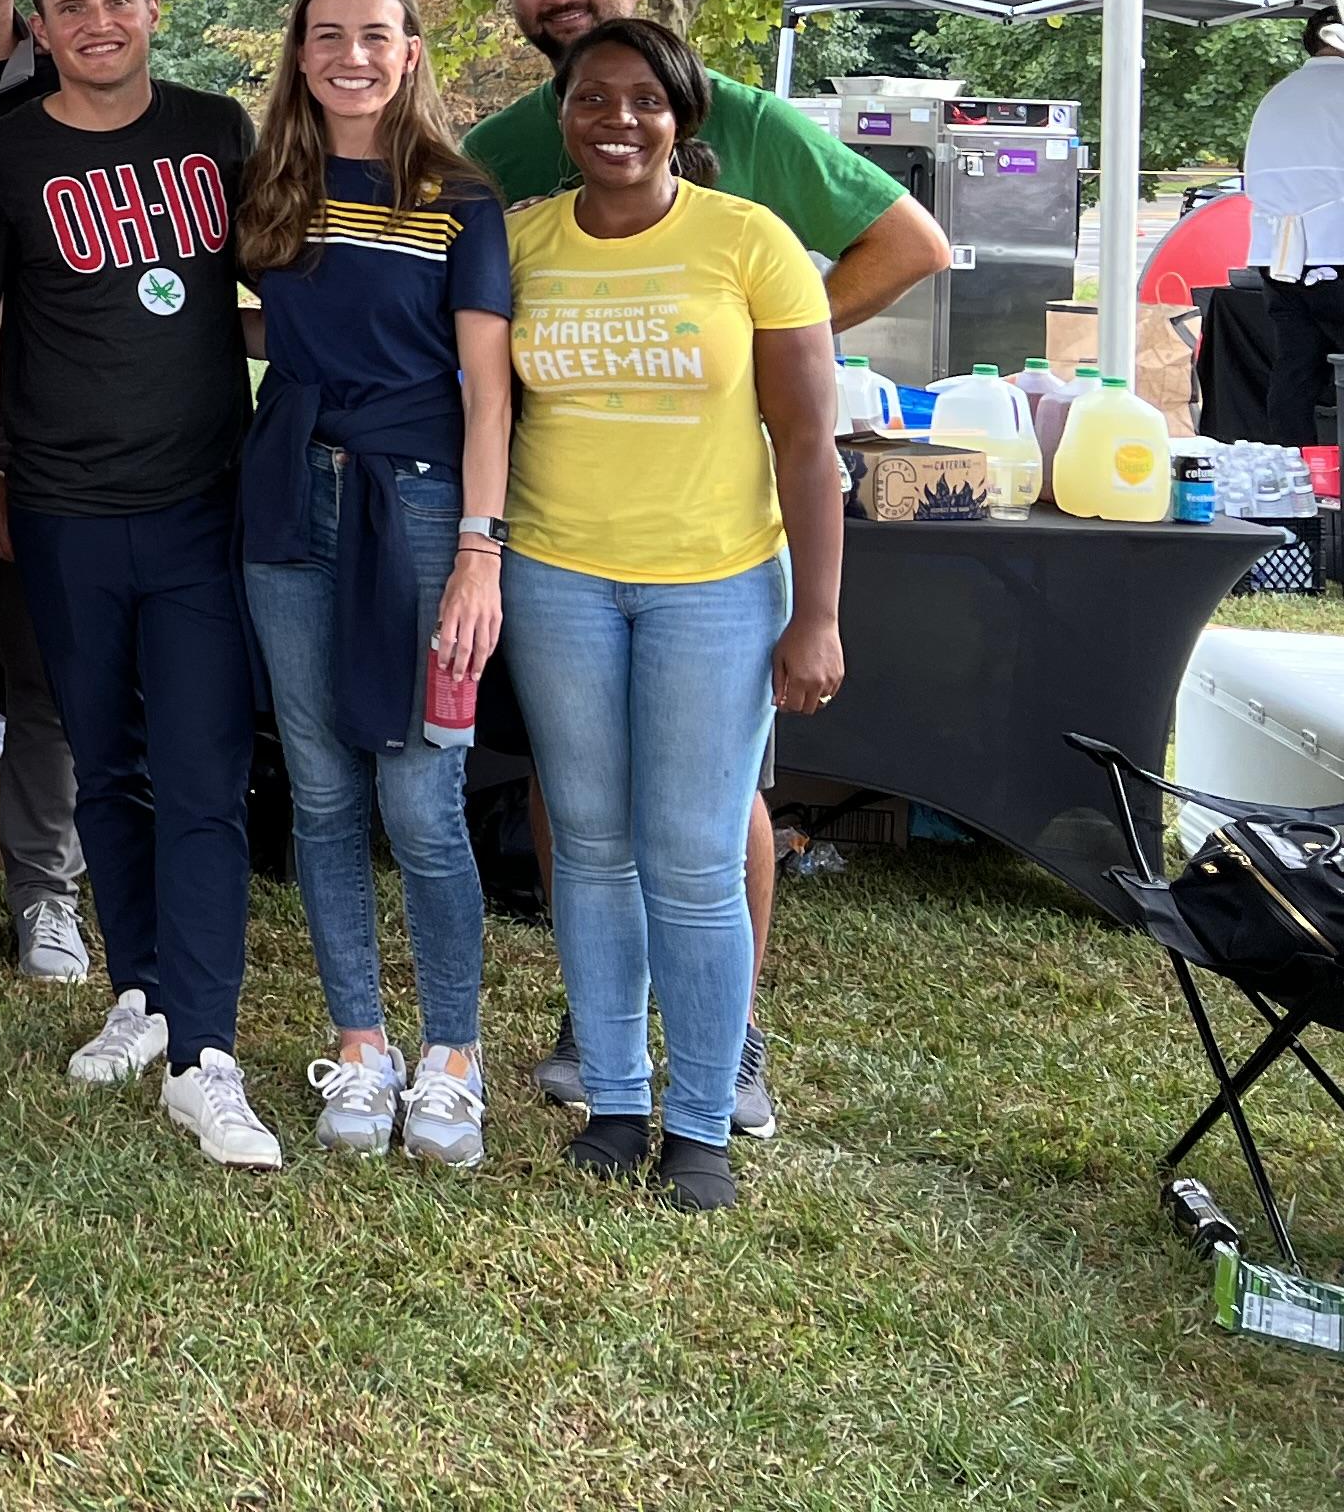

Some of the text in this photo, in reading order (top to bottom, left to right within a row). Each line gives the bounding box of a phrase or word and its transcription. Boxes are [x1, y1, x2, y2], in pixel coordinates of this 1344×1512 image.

[555, 307, 581, 318] THE
[585, 306, 645, 318] SEASON
[650, 304, 679, 315] FOR
[534, 318, 670, 346] MARCUS
[518, 346, 703, 381] FREEMAN
